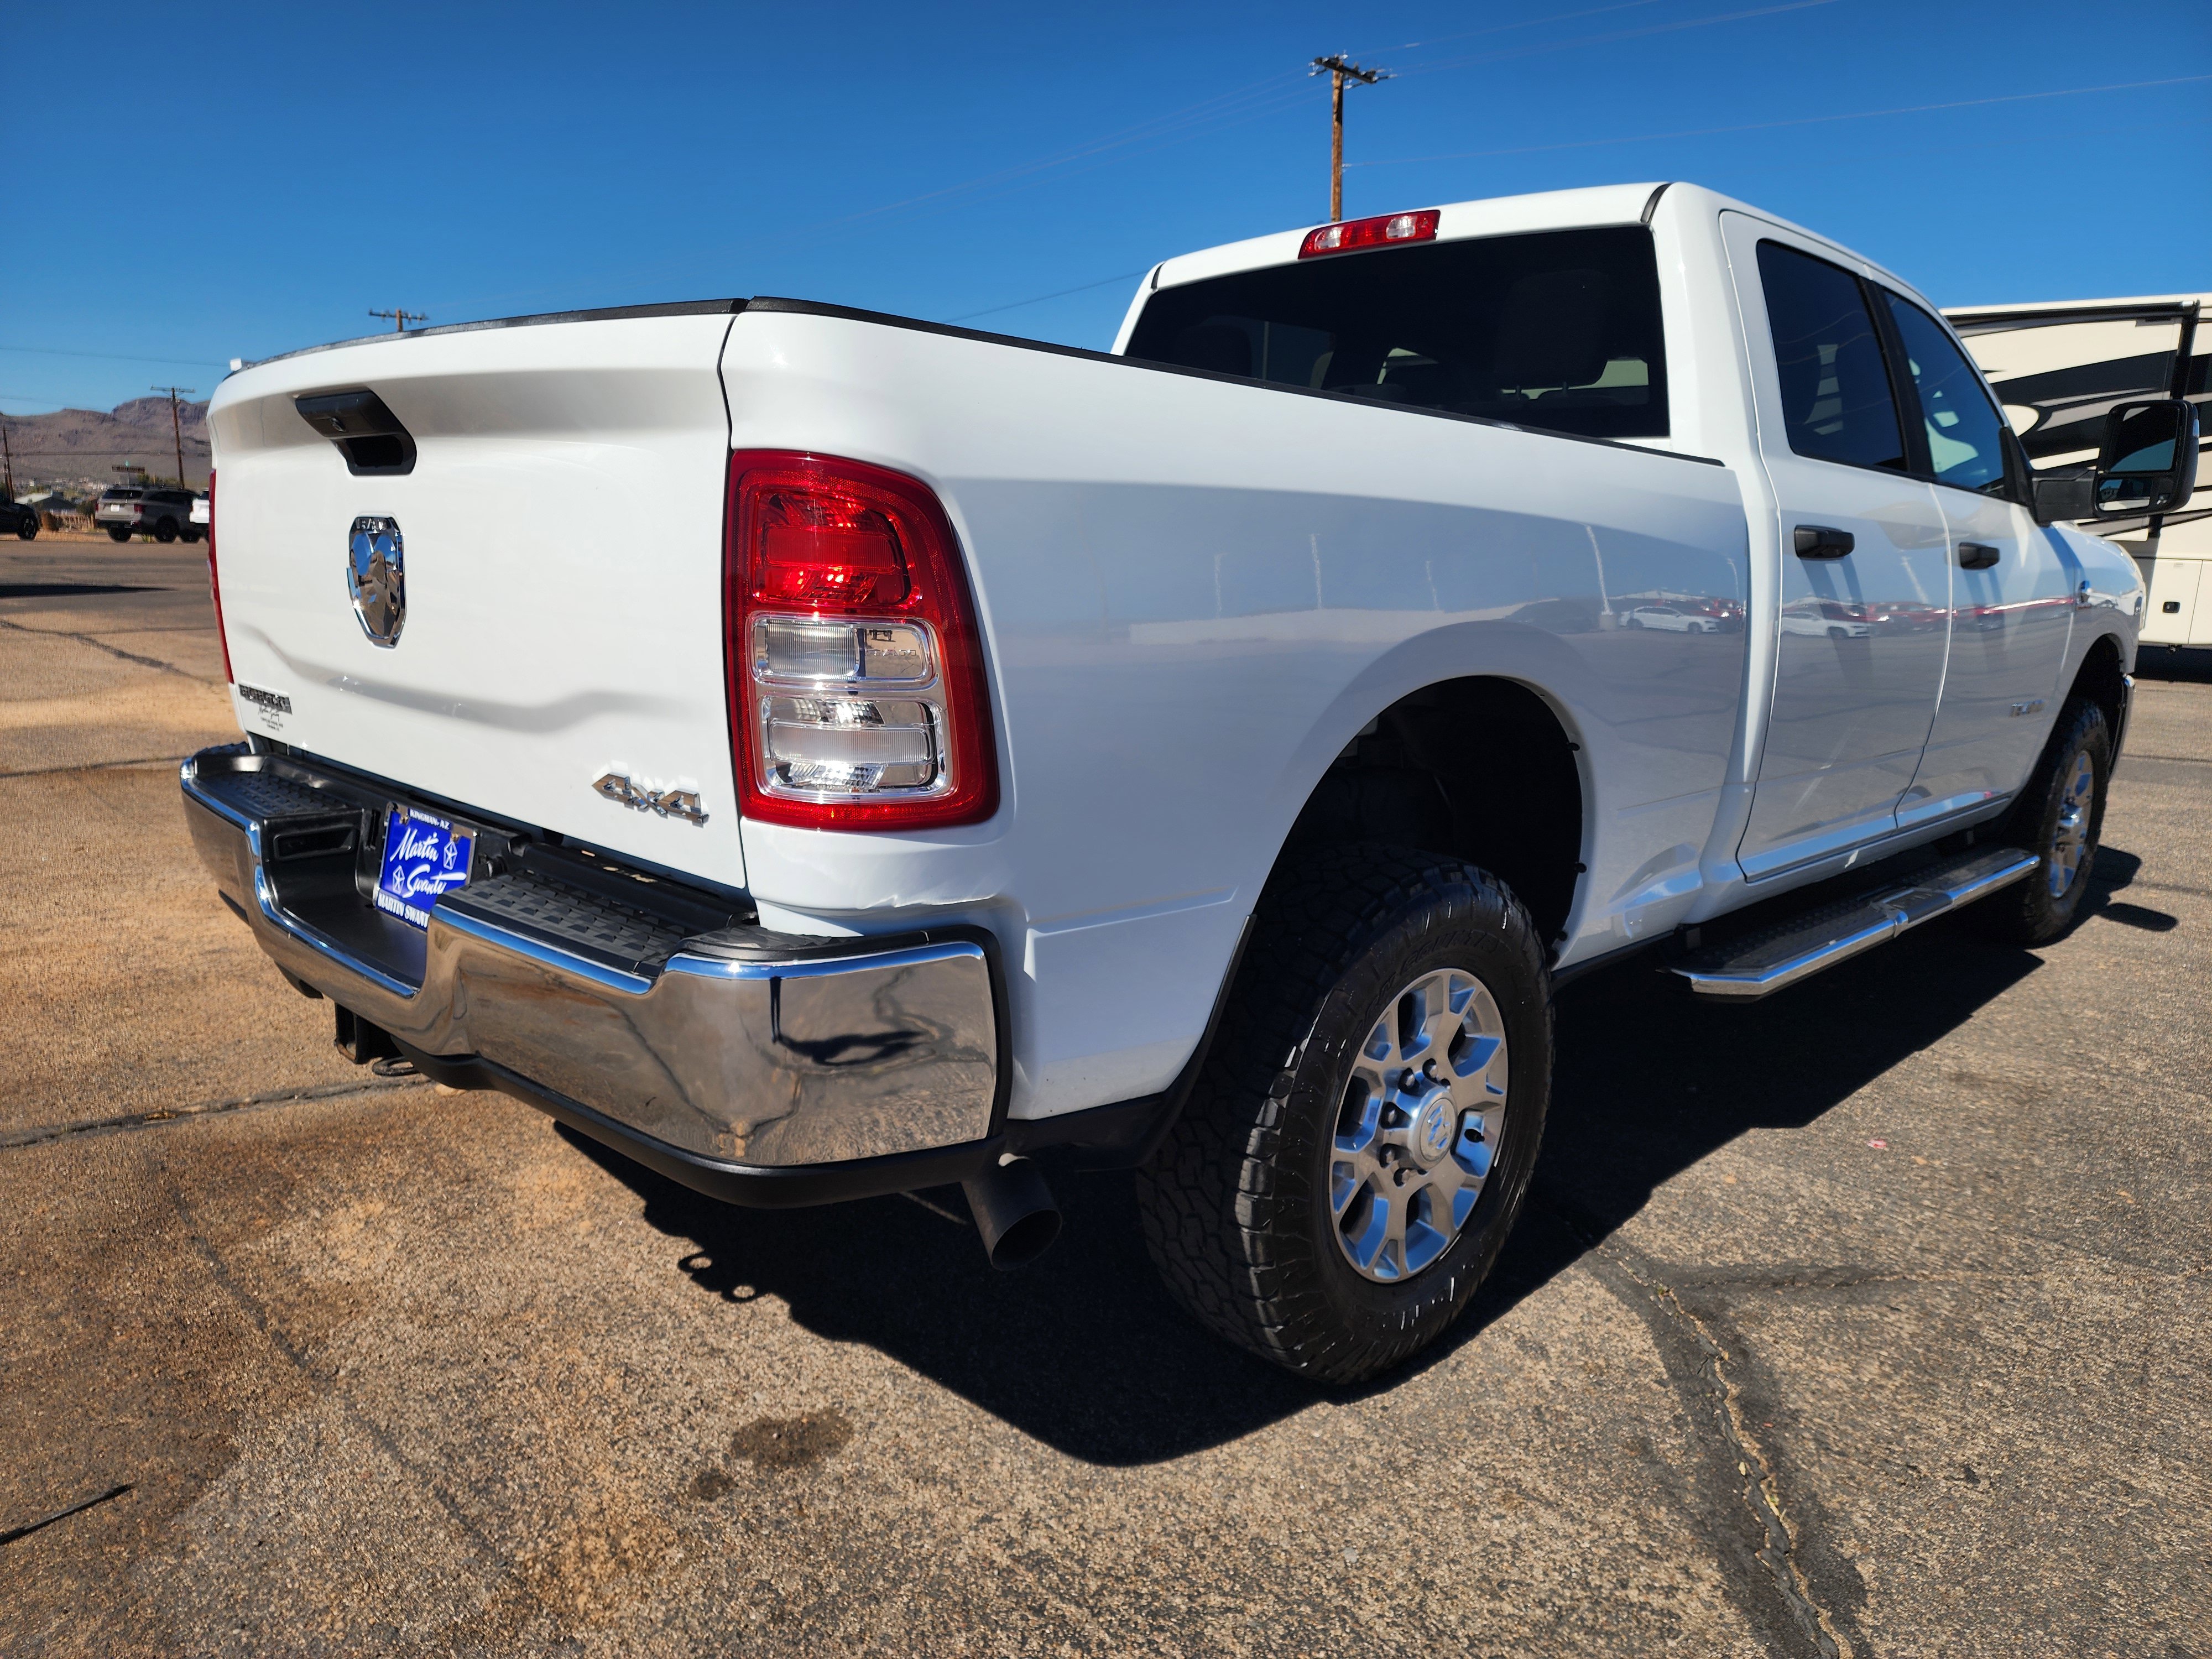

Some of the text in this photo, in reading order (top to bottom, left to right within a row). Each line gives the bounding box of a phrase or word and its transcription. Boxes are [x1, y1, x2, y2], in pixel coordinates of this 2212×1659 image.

[440, 819, 450, 830] AZ
[389, 827, 440, 863] Martin
[402, 864, 467, 899] Swanty
[377, 891, 405, 917] MARTIN
